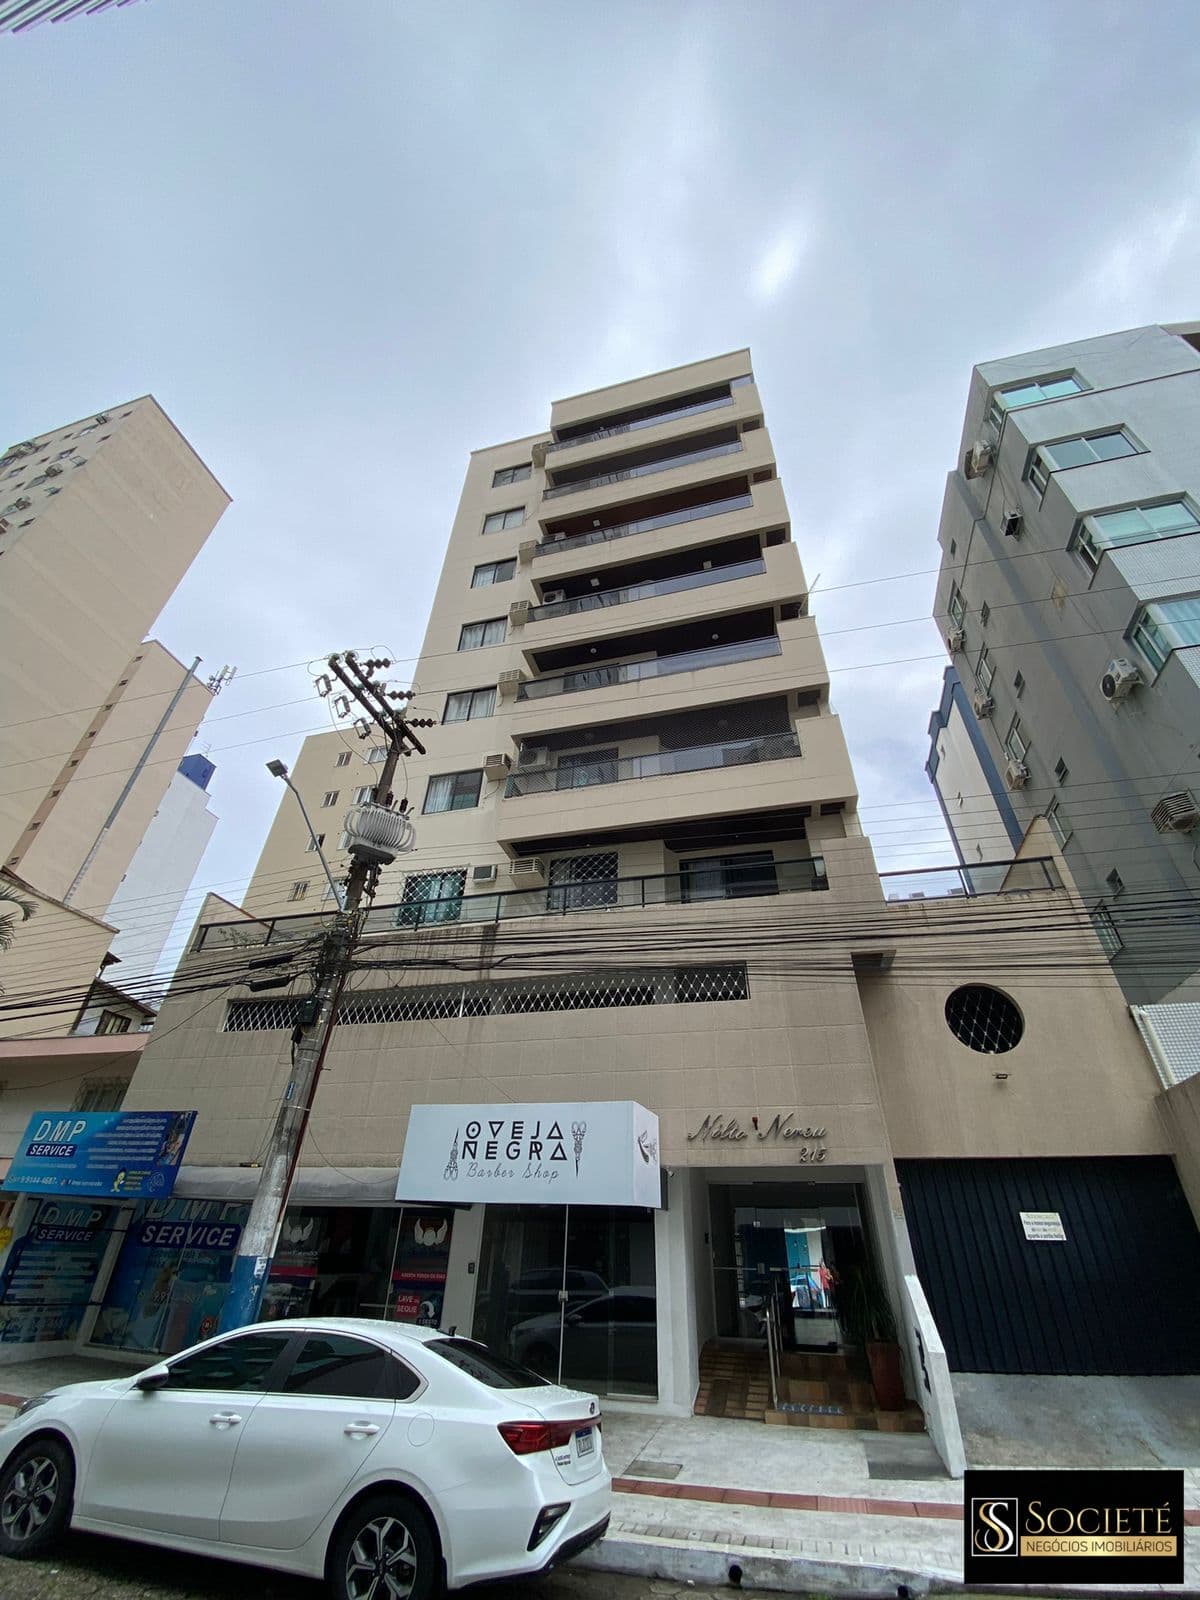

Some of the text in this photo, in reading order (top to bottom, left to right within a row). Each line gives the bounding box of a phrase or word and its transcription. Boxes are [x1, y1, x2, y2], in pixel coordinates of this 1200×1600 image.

[33, 1119, 87, 1142] DMP
[466, 1120, 564, 1140] OVEJA
[30, 1145, 74, 1156] SERVICE
[462, 1141, 568, 1160] NEGRA
[800, 1147, 827, 1163] 215
[466, 1161, 560, 1184] Barber Shop
[43, 1207, 102, 1228] DMP
[38, 1229, 93, 1241] SERVICE
[142, 1225, 236, 1246] SERVICE
